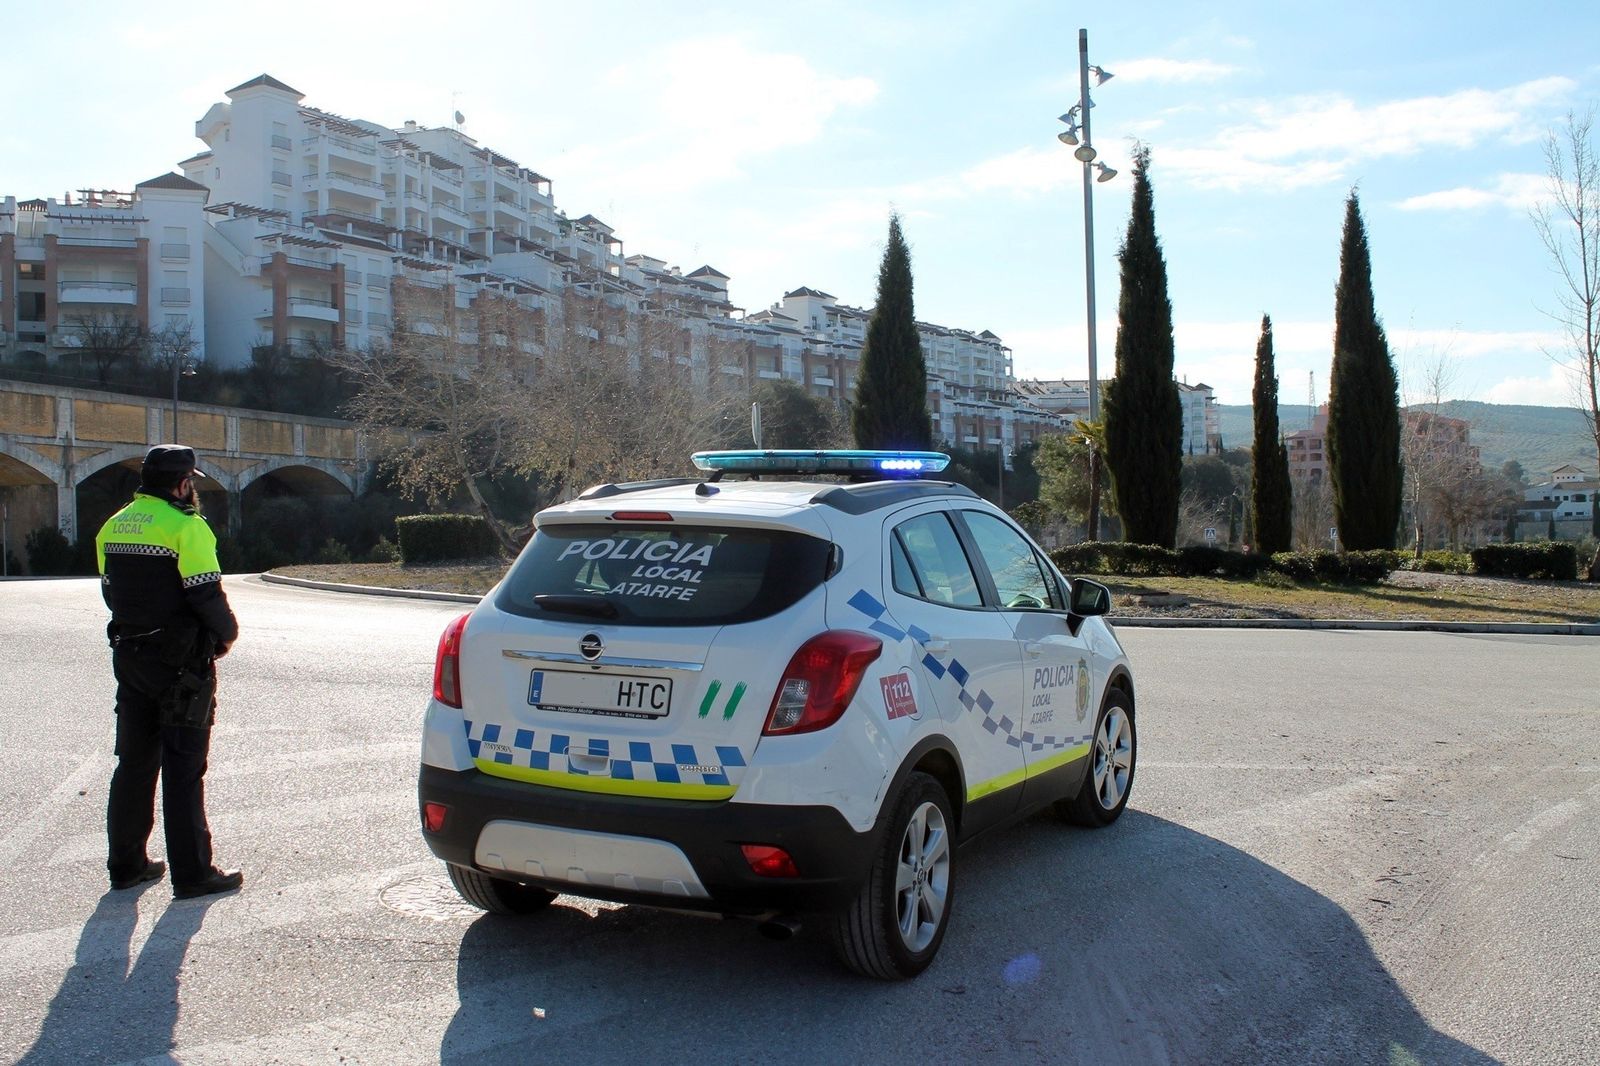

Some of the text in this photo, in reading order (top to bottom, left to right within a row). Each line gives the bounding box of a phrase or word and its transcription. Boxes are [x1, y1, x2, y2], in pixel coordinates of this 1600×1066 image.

[112, 523, 143, 535] LOCAL
[557, 539, 713, 566] POLICIA
[631, 565, 703, 583] LOCAL
[608, 582, 697, 601] ATARFE
[1032, 664, 1074, 690] POLICIA
[533, 680, 666, 710] E HTC
[891, 681, 911, 699] 112
[1032, 694, 1051, 707] LOCAL
[1030, 710, 1054, 725] ATARFE
